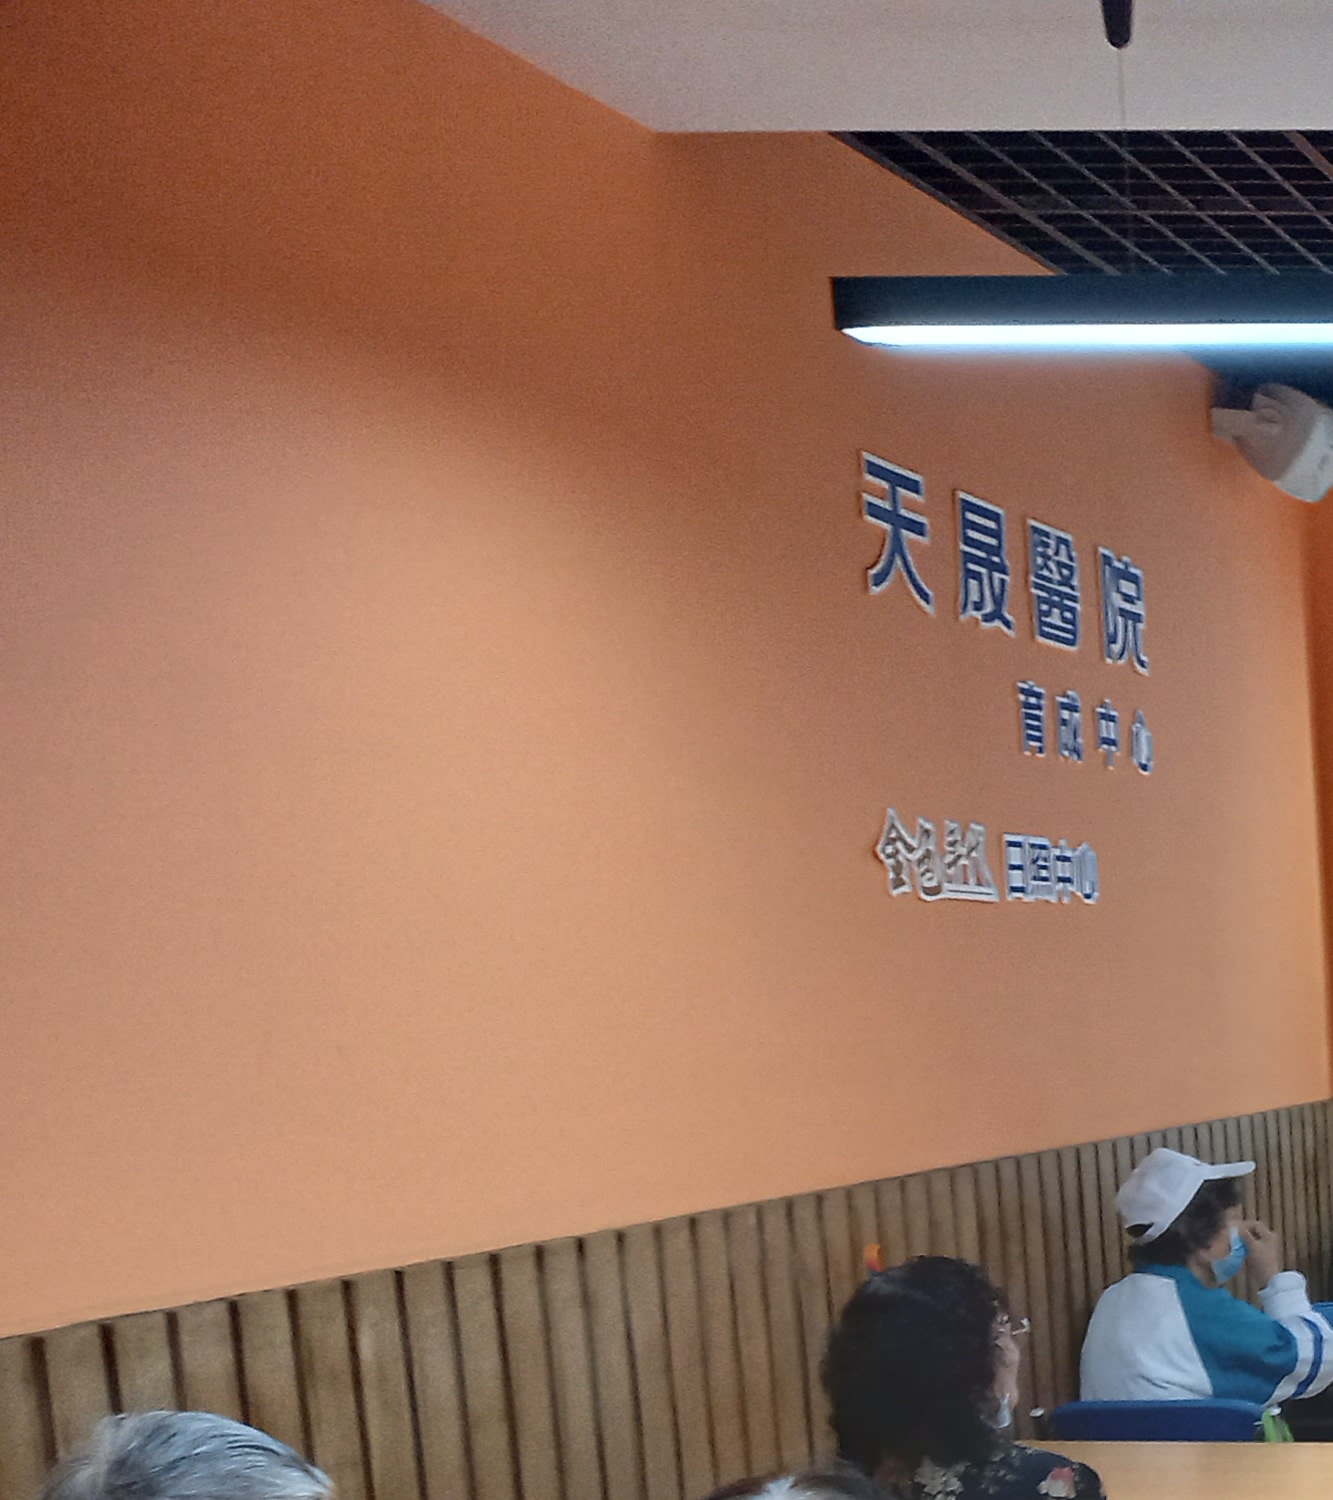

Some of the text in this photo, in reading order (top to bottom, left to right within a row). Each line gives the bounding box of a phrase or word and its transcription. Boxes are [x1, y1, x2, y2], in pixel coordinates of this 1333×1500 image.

[860, 450, 1150, 676] 天晟醫院
[1017, 680, 1154, 775] 育成中心
